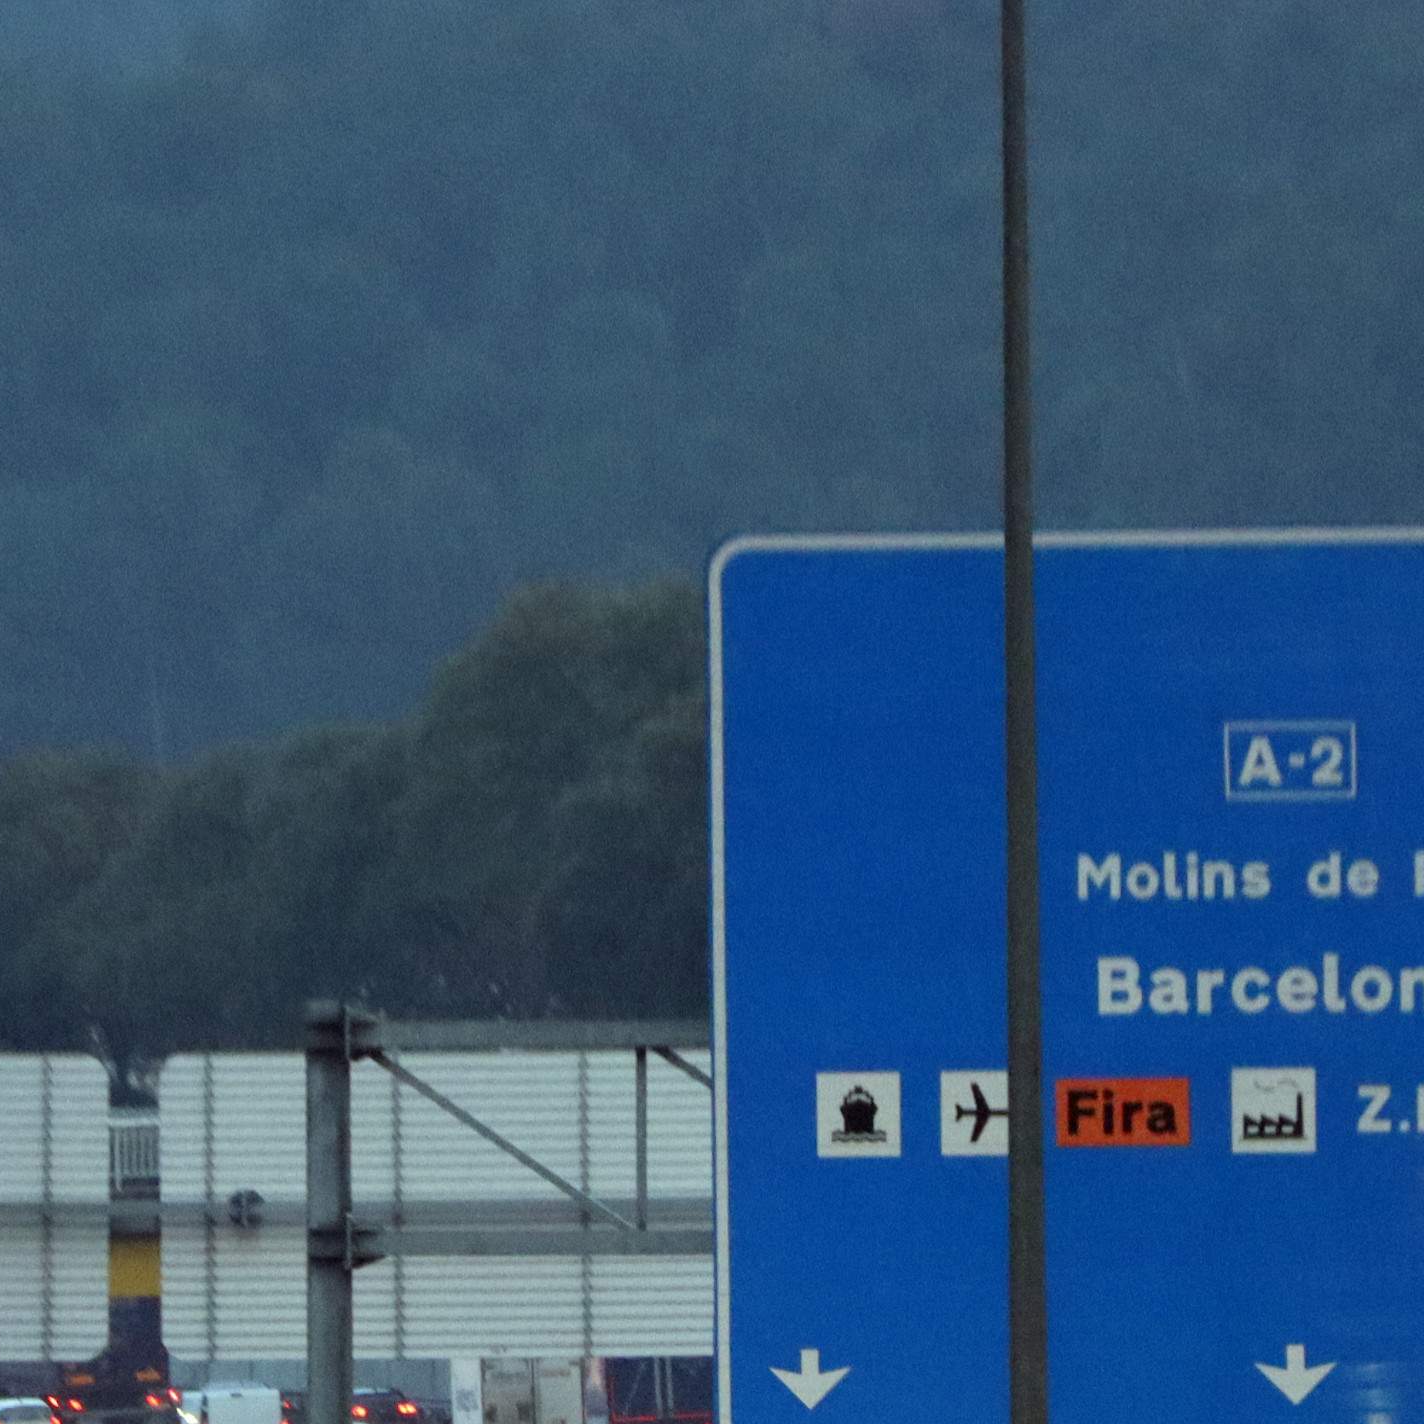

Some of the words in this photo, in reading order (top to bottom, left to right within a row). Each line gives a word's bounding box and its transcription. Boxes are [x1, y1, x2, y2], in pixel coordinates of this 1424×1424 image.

[1238, 735, 1344, 787] A-2
[1076, 851, 1273, 901] Molins
[1305, 850, 1381, 899] de
[1065, 1087, 1178, 1137] Fira
